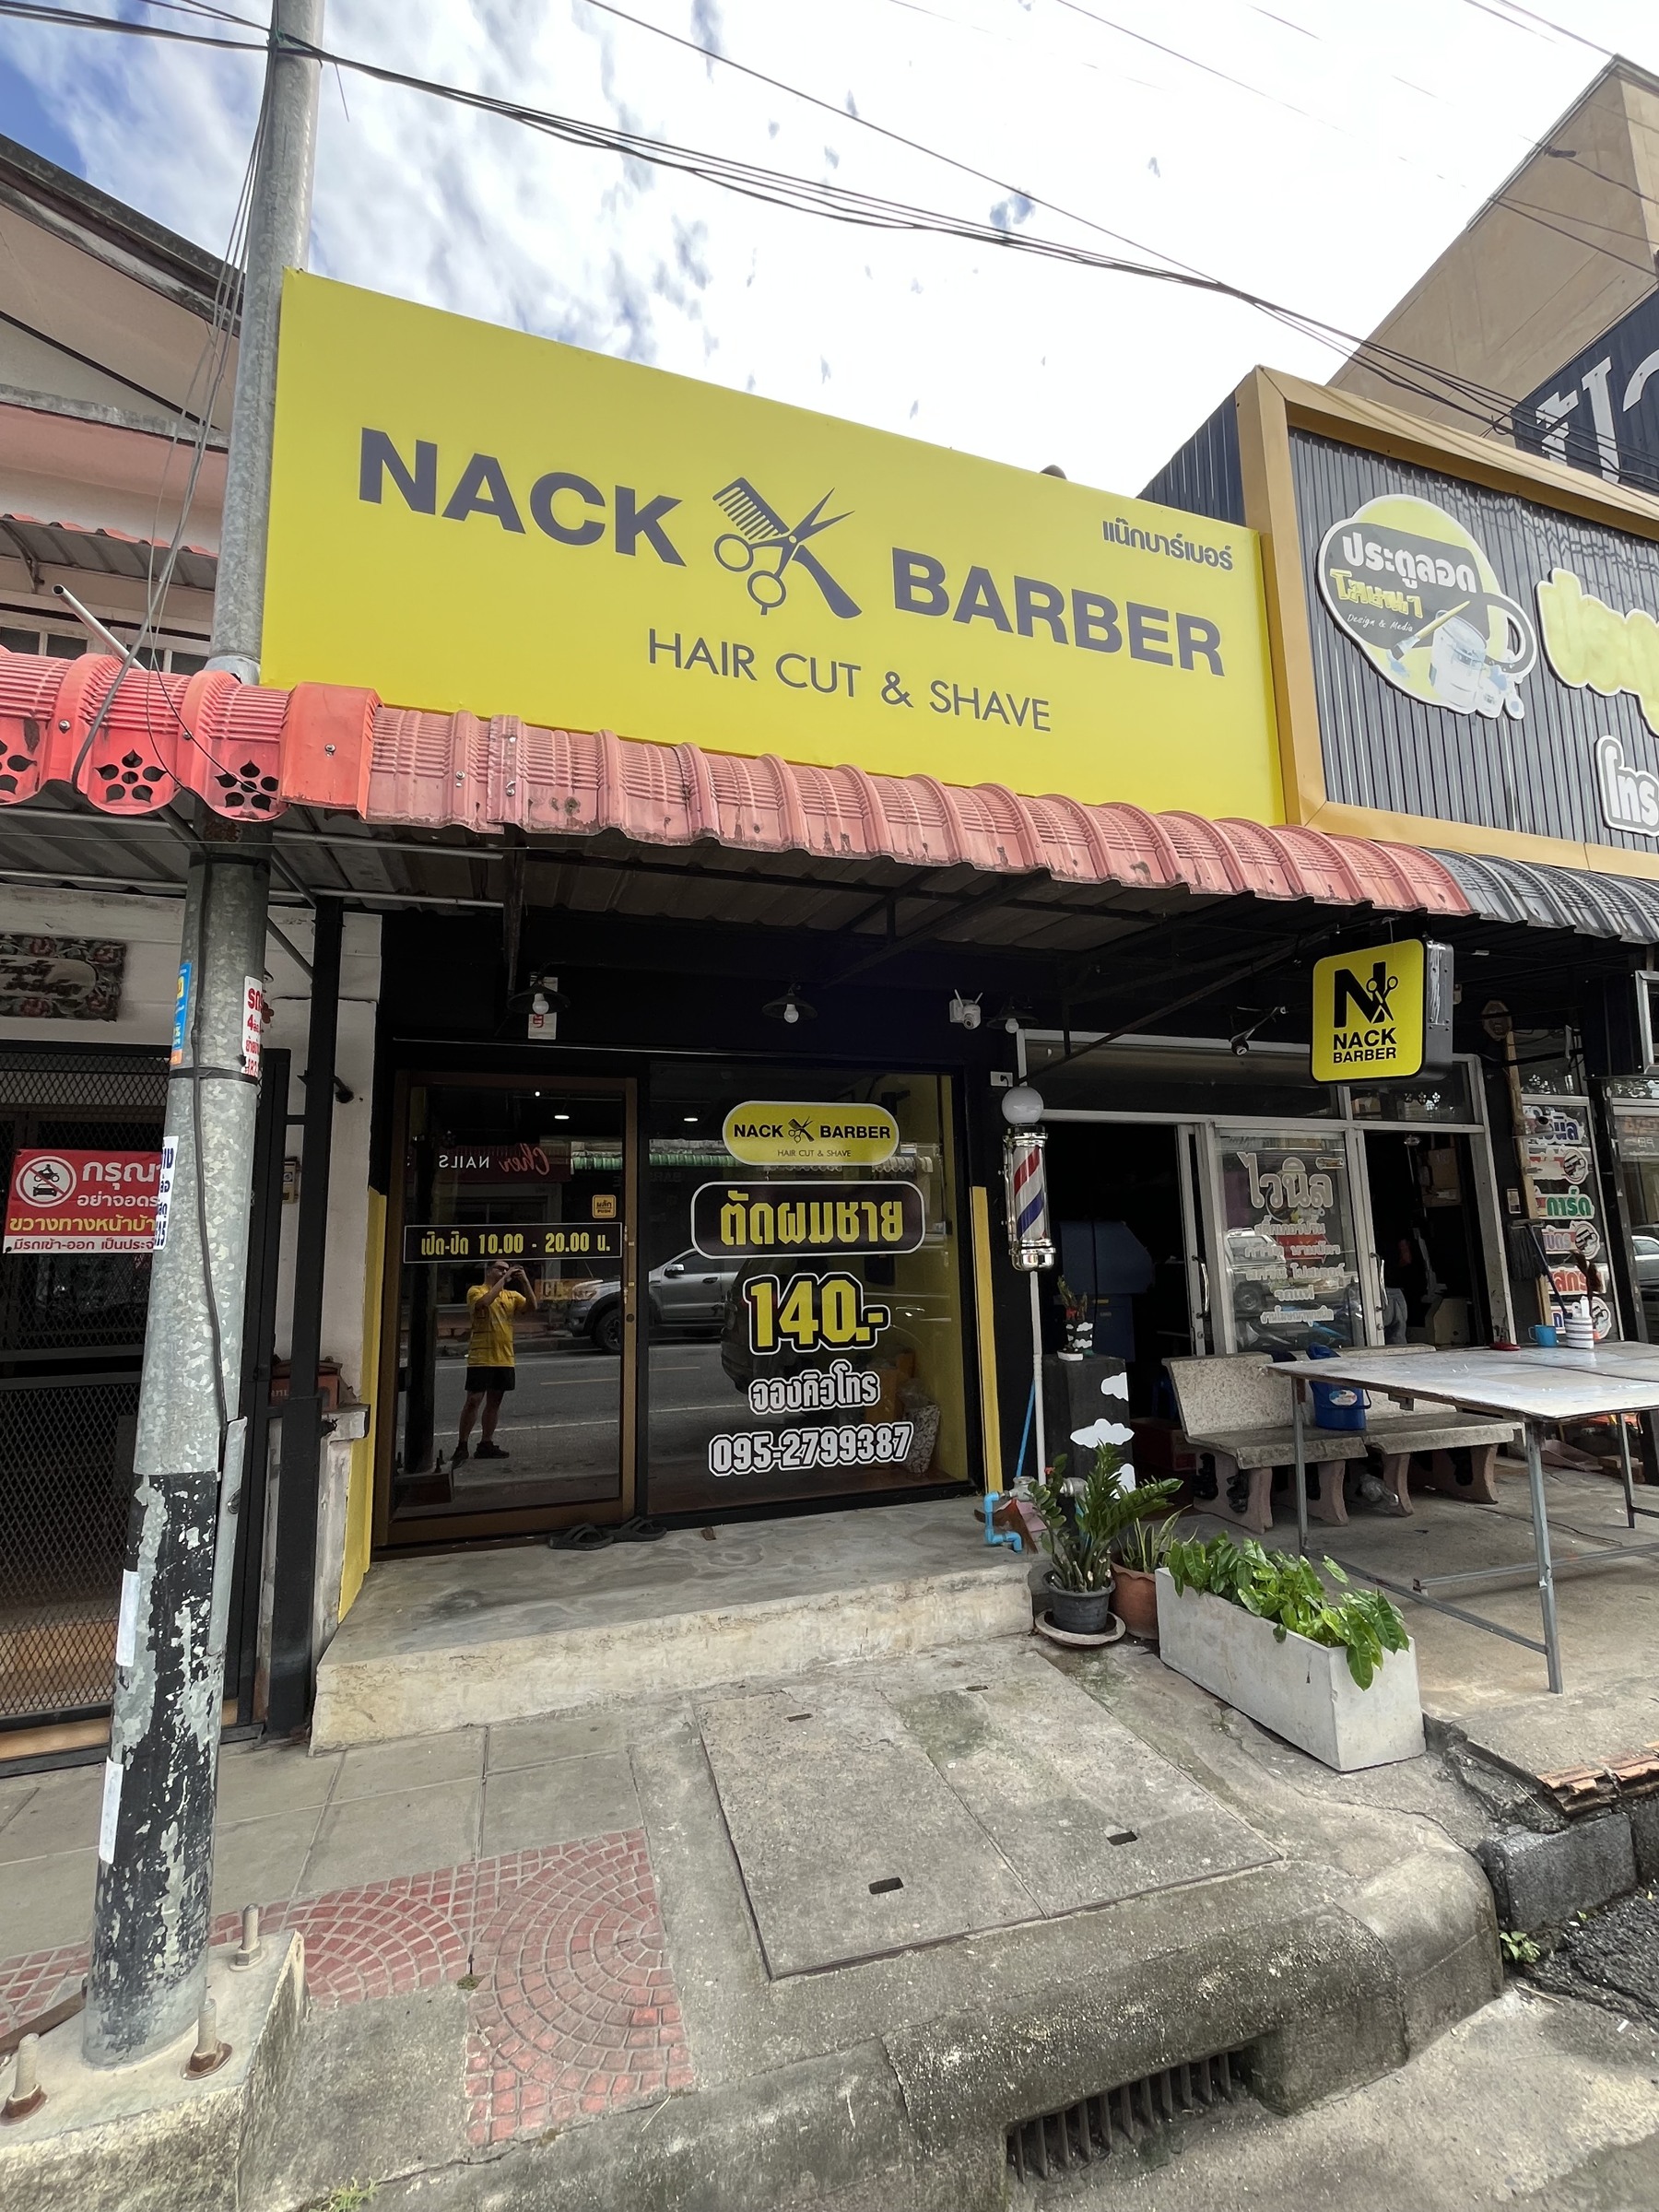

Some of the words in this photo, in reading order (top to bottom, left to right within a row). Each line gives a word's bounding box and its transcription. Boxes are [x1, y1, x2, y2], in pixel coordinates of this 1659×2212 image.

[358, 427, 687, 568] NACK
[892, 547, 1224, 677] BARBER
[1342, 532, 1477, 594] ประตูลอด
[1347, 614, 1375, 629] Design
[1390, 620, 1413, 632] Media
[648, 629, 755, 681] HAIR
[776, 652, 861, 699] CUT
[885, 672, 912, 708] &
[930, 680, 1052, 732] SHAVE
[1333, 1027, 1397, 1051] NACK
[1333, 1047, 1396, 1064] BARBER
[734, 1124, 784, 1138] NACK
[819, 1125, 890, 1139] BARBER
[777, 1149, 796, 1158] HAIR
[798, 1149, 815, 1158] CUT
[827, 1149, 852, 1158] SHAVE
[1236, 1151, 1334, 1209] ไวนิล
[1547, 1187, 1593, 1217] การ์ด
[9, 1215, 155, 1231] ขวางทางหน้าบ้า
[720, 1190, 903, 1246] ตัดผมชาย
[421, 1231, 469, 1255] เปิด-ปิด
[479, 1233, 524, 1254] 10.00
[545, 1232, 590, 1253] 20.00
[597, 1234, 610, 1252] น.
[751, 1360, 879, 1413] จองคิวโทร
[711, 1424, 912, 1474] 095-2799387
